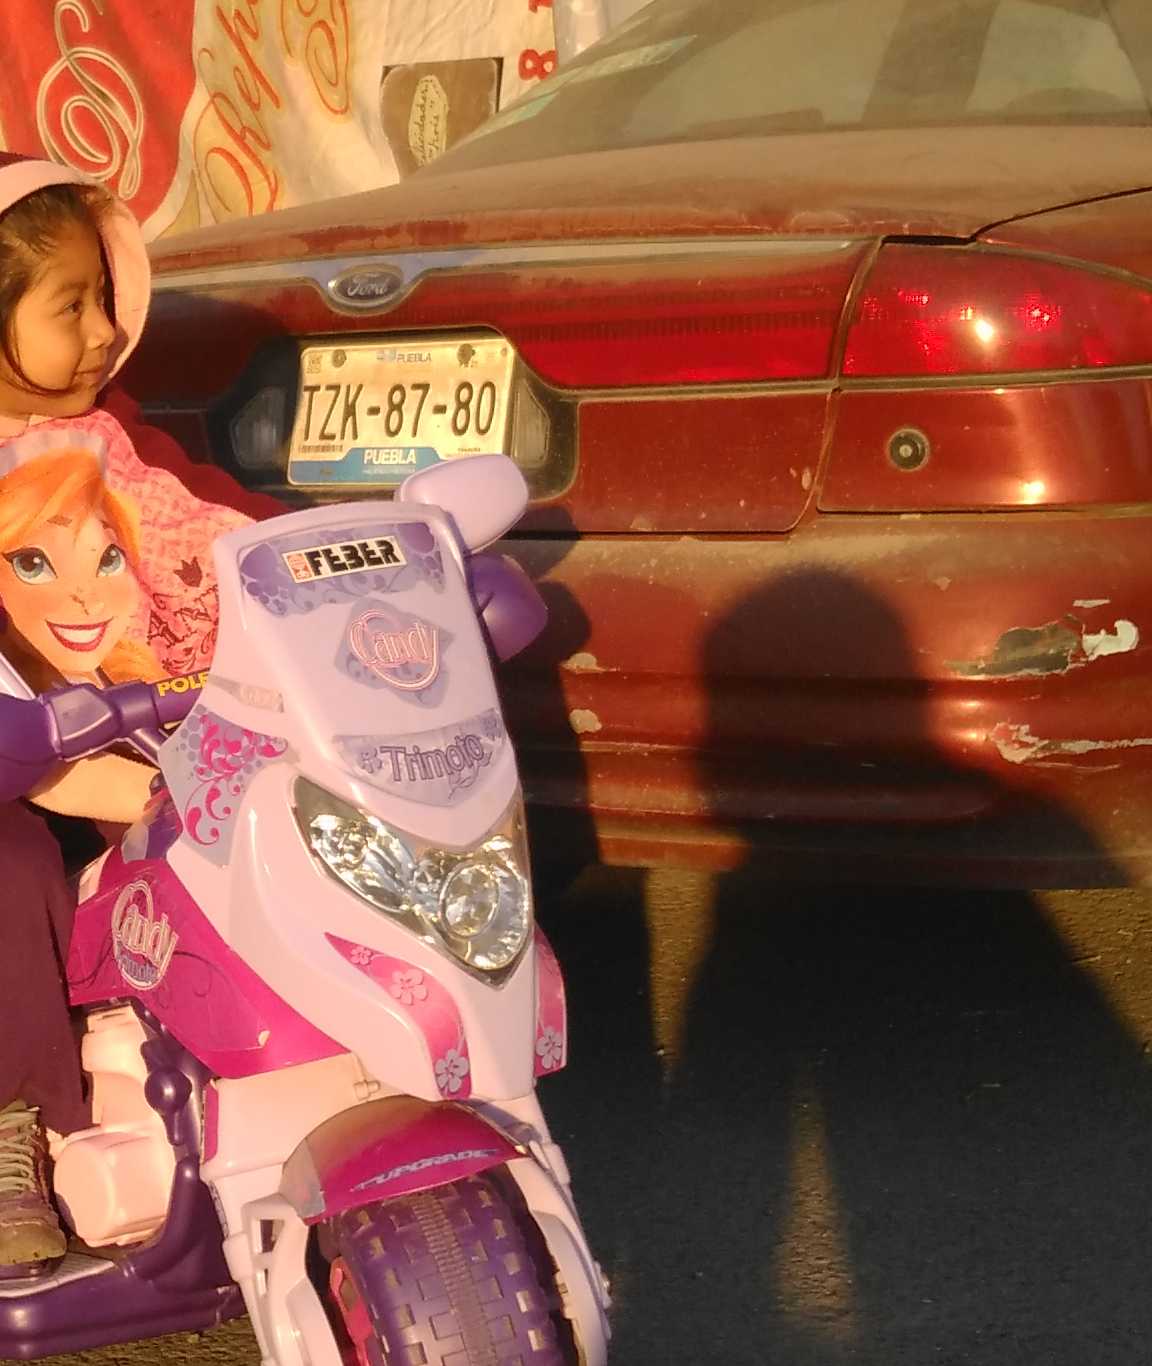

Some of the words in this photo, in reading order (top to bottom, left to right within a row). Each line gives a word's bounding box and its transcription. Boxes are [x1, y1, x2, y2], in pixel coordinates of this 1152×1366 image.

[396, 351, 432, 364] PUEBLA
[301, 380, 497, 442] TZK-87-80
[362, 448, 418, 466] PUEBLA
[304, 539, 401, 577] FEBER
[350, 609, 440, 691] Candy
[380, 733, 484, 783] Trimoto
[111, 879, 180, 991] Candy
